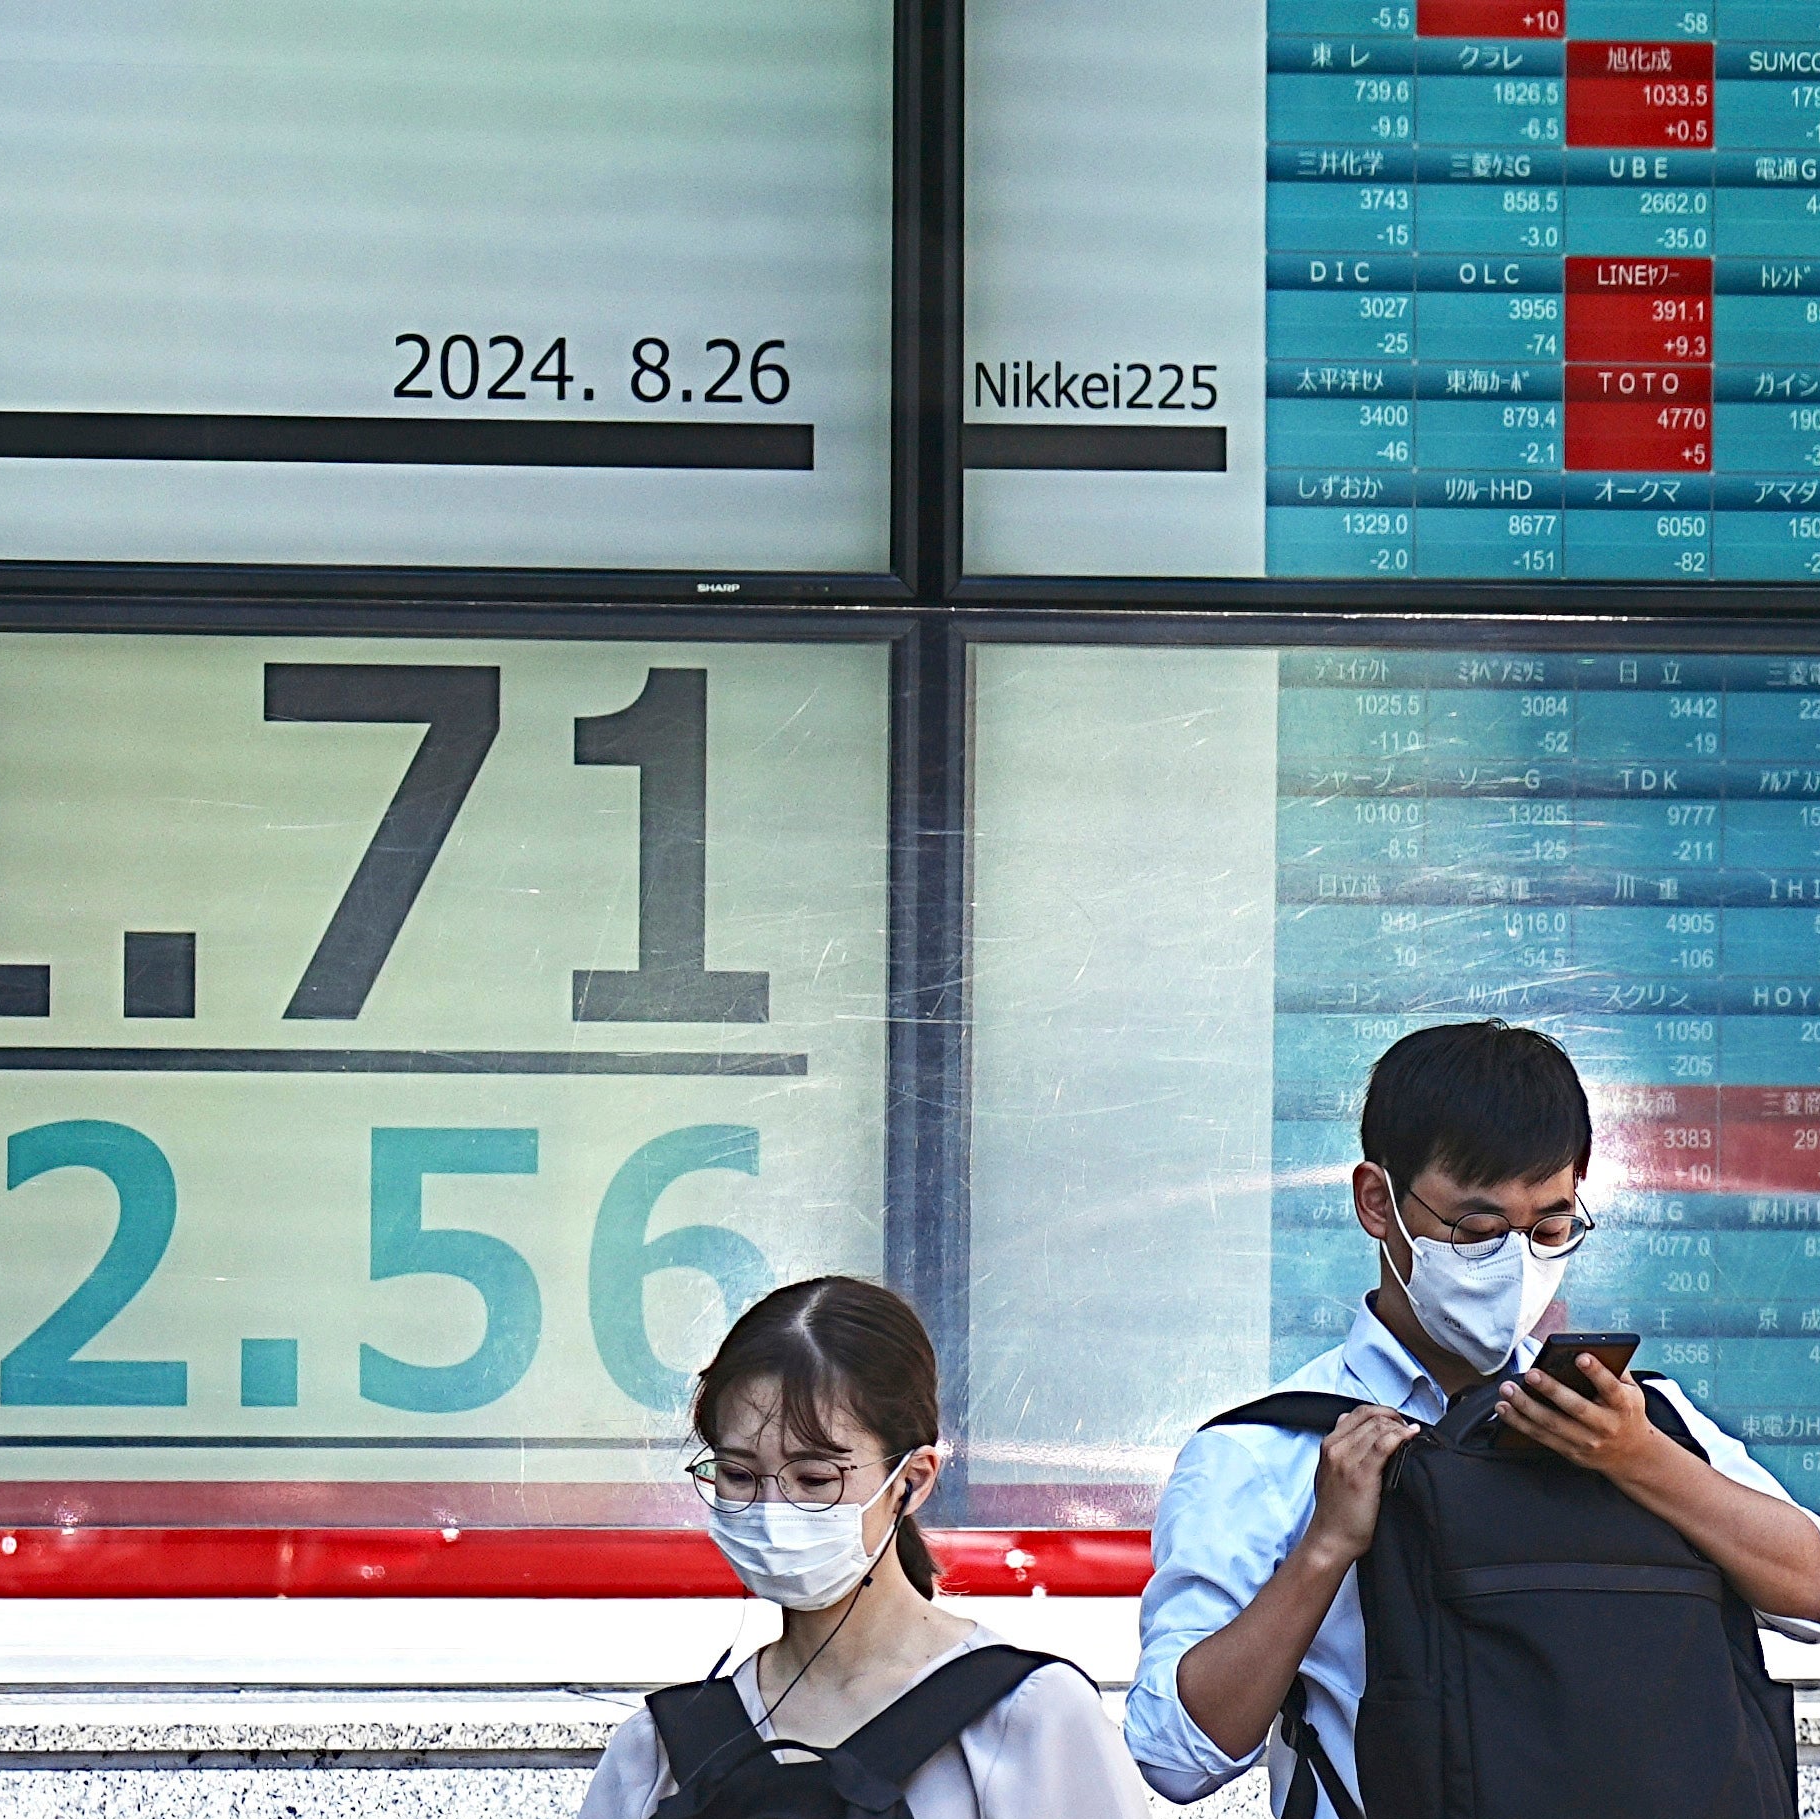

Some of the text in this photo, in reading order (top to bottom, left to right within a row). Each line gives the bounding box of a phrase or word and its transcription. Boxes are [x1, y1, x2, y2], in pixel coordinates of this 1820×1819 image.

[1523, 10, 1558, 30] +10
[1459, 45, 1522, 69] クラレ
[1607, 49, 1672, 71] 旭化成
[1494, 79, 1561, 105] 1826.5
[1643, 85, 1707, 106] 1033.5
[1665, 120, 1706, 140] +0.5
[1641, 192, 1707, 213] 2662.0
[1657, 228, 1706, 249] -35.0
[1653, 300, 1703, 321] 391.1
[1664, 336, 1705, 356] +9.3
[974, 357, 1220, 413] Nikkei225
[1657, 408, 1705, 429] 4770
[1681, 444, 1705, 464] +5
[1596, 478, 1681, 502] オークマ
[1756, 480, 1818, 503] アマダ
[1343, 513, 1408, 534] 1329.0
[1657, 516, 1705, 537] 6050
[1674, 552, 1705, 572] -82
[697, 583, 740, 593] SHARP
[1670, 697, 1717, 718] 3442
[1686, 733, 1717, 754] -19
[1667, 805, 1716, 825] 9777
[1672, 840, 1713, 861] -211
[1671, 948, 1714, 969] -106
[1655, 1020, 1713, 1041] 11050
